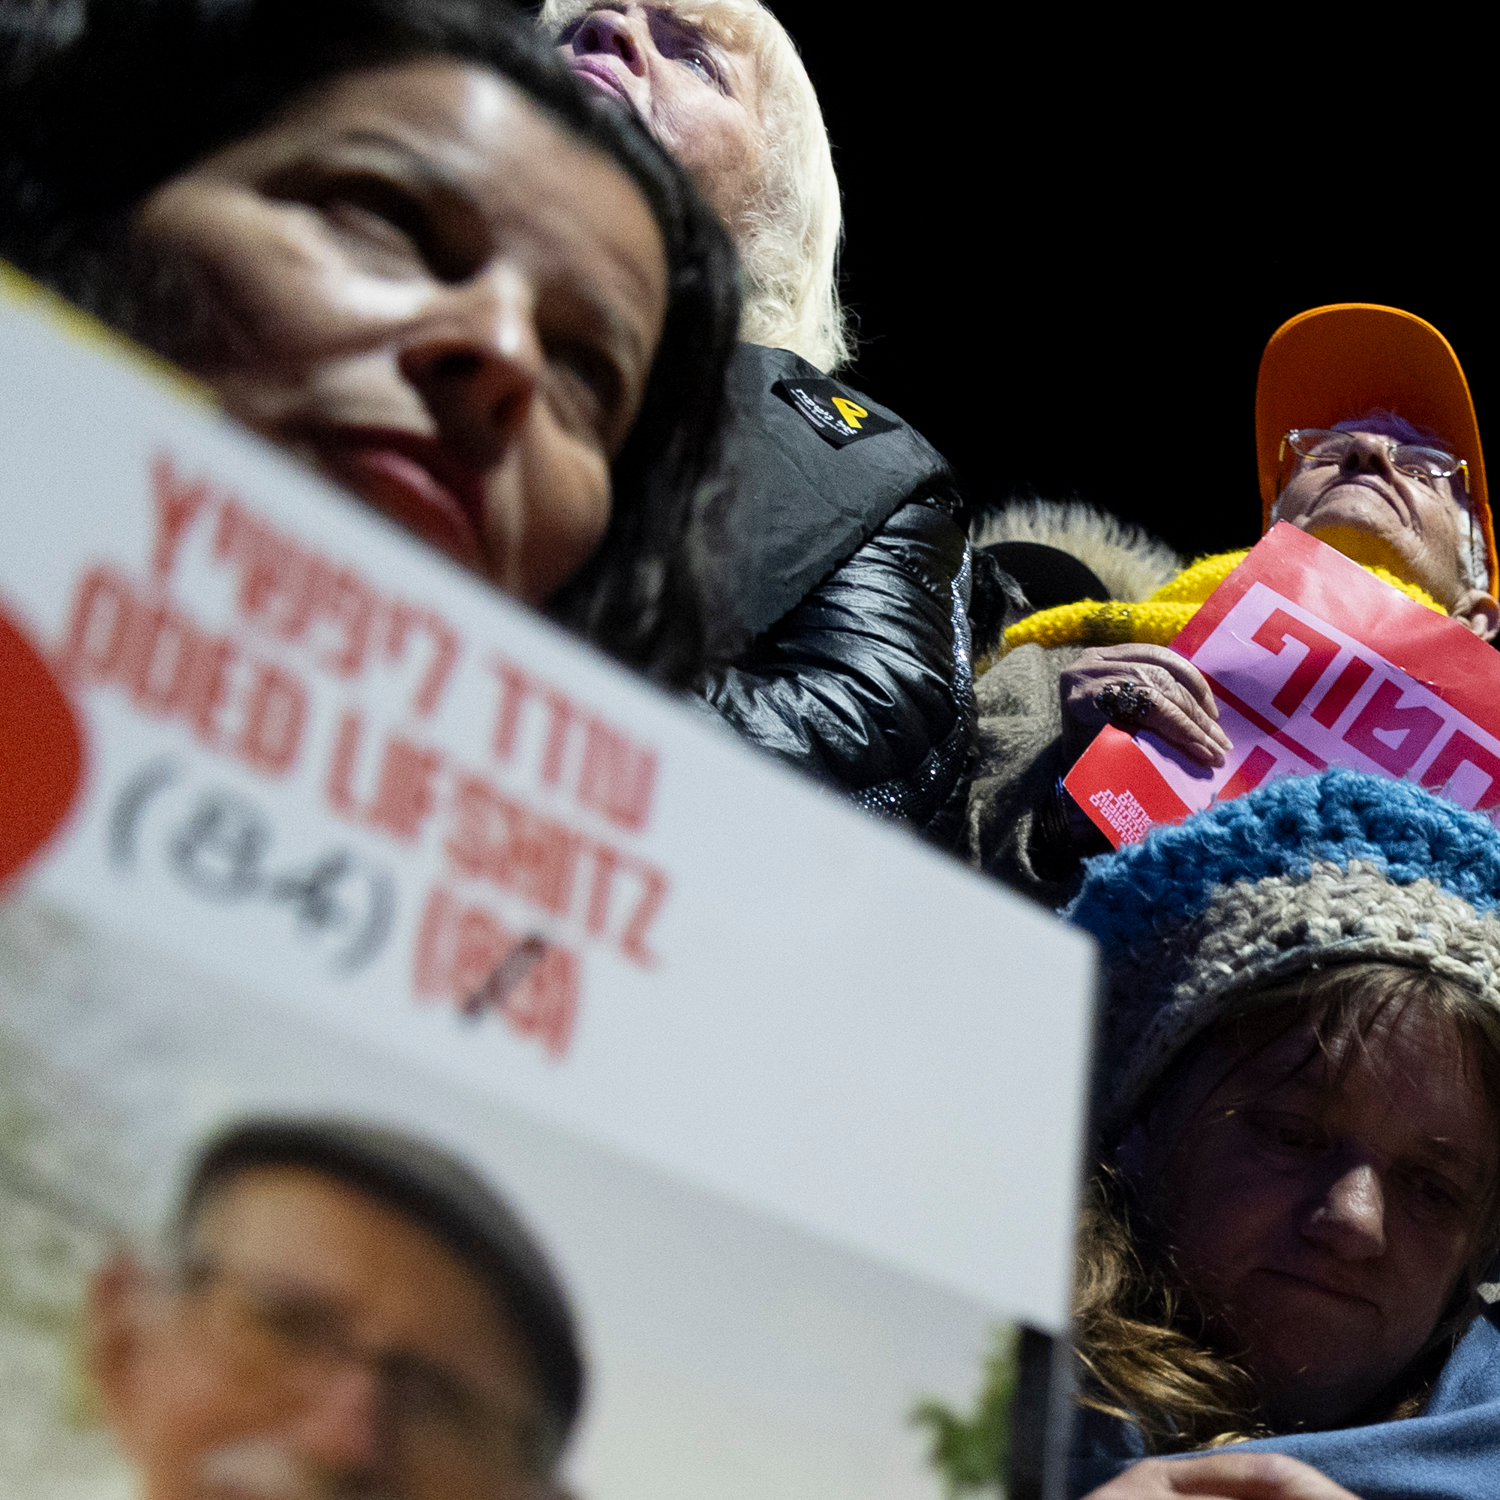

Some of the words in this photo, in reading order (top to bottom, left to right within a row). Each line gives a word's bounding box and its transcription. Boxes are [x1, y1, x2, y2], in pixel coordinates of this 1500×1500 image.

[61, 556, 310, 782] ODED
[322, 698, 672, 976] LIFSHITZ
[105, 756, 402, 980] (84)
